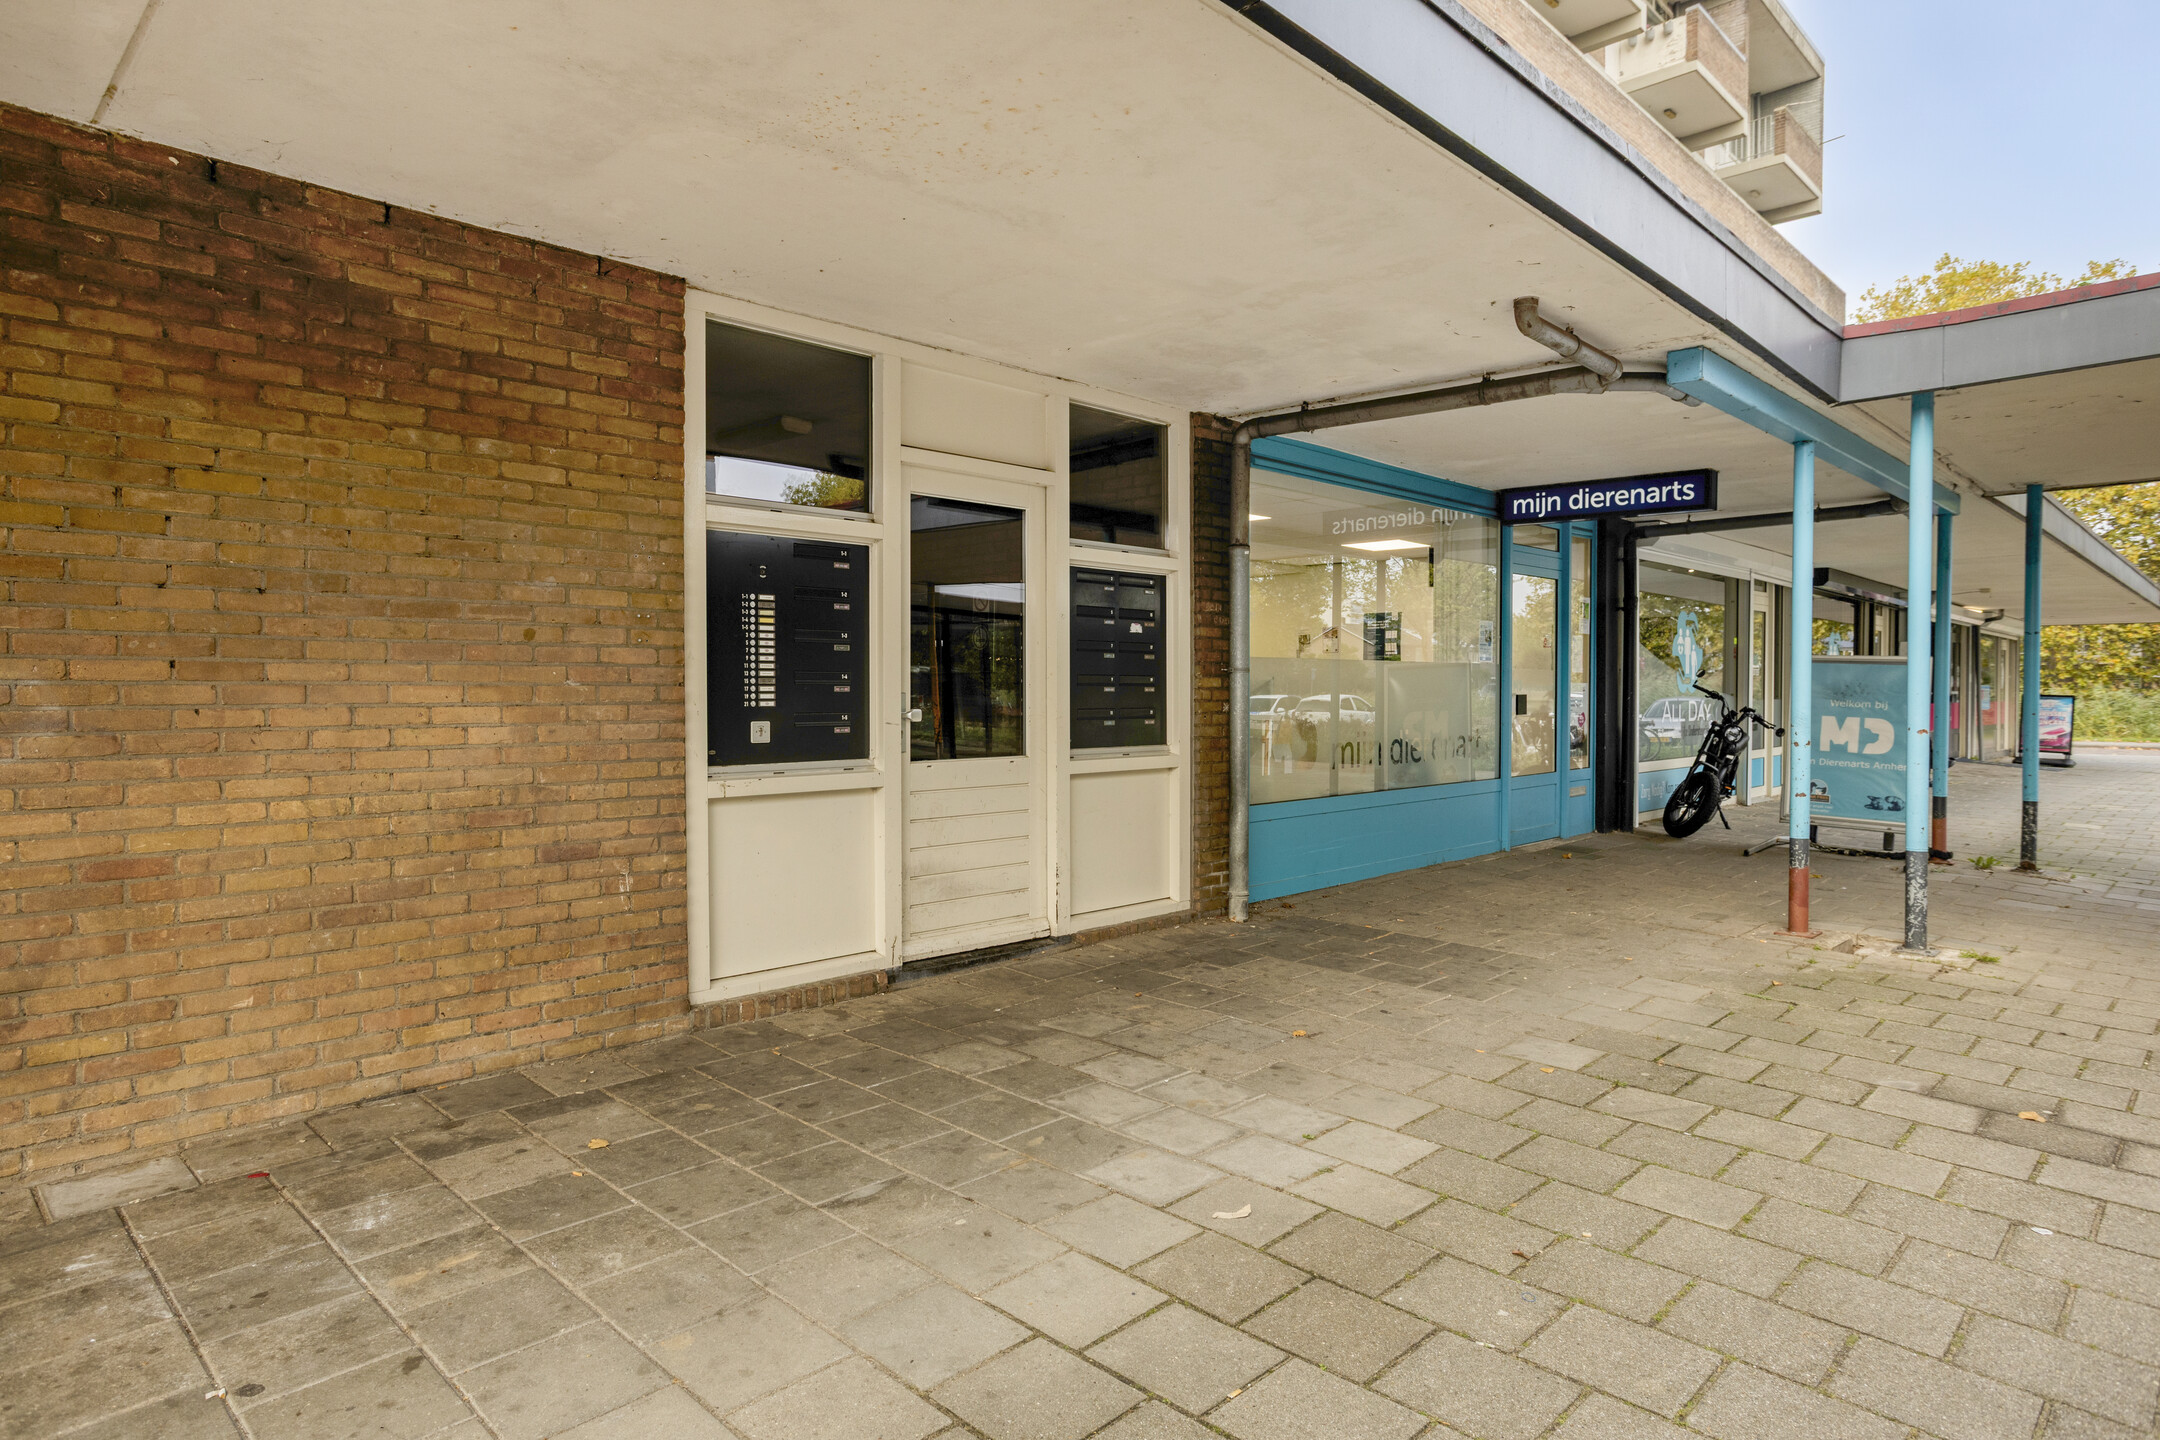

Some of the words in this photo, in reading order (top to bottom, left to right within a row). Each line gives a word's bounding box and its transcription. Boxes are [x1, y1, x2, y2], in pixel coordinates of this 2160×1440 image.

[1512, 492, 1561, 517] mijn
[1568, 481, 1695, 510] dierenarts
[1661, 701, 1686, 723] ALL
[1688, 700, 1711, 722] DAY
[1830, 699, 1871, 709] Welkom
[1874, 701, 1889, 711] bij
[1820, 715, 1895, 755] MD
[1818, 758, 1871, 769] Dierenarts
